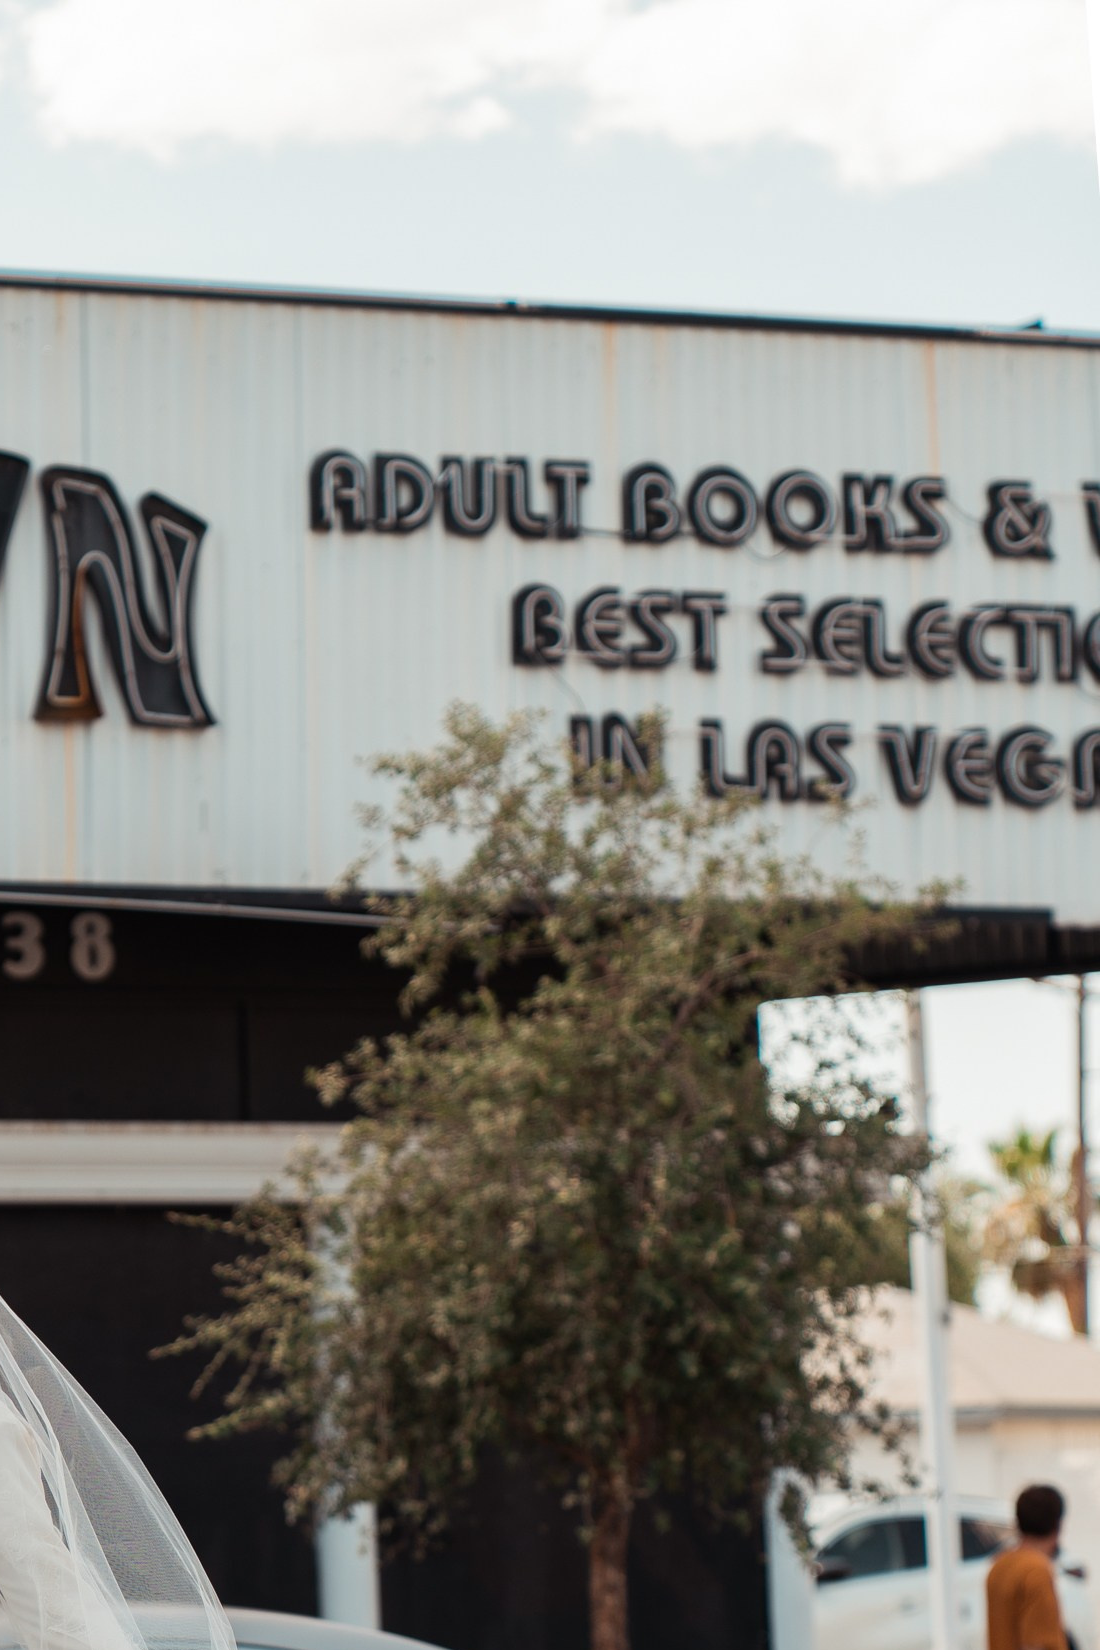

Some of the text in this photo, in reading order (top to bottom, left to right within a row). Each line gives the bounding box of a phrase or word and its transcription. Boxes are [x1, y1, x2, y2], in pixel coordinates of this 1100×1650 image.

[309, 449, 590, 540] ADULT
[622, 462, 950, 555] BOOKS
[982, 481, 1055, 560] &
[511, 583, 1100, 684] BEST SELECTI
[699, 719, 857, 803] LAS
